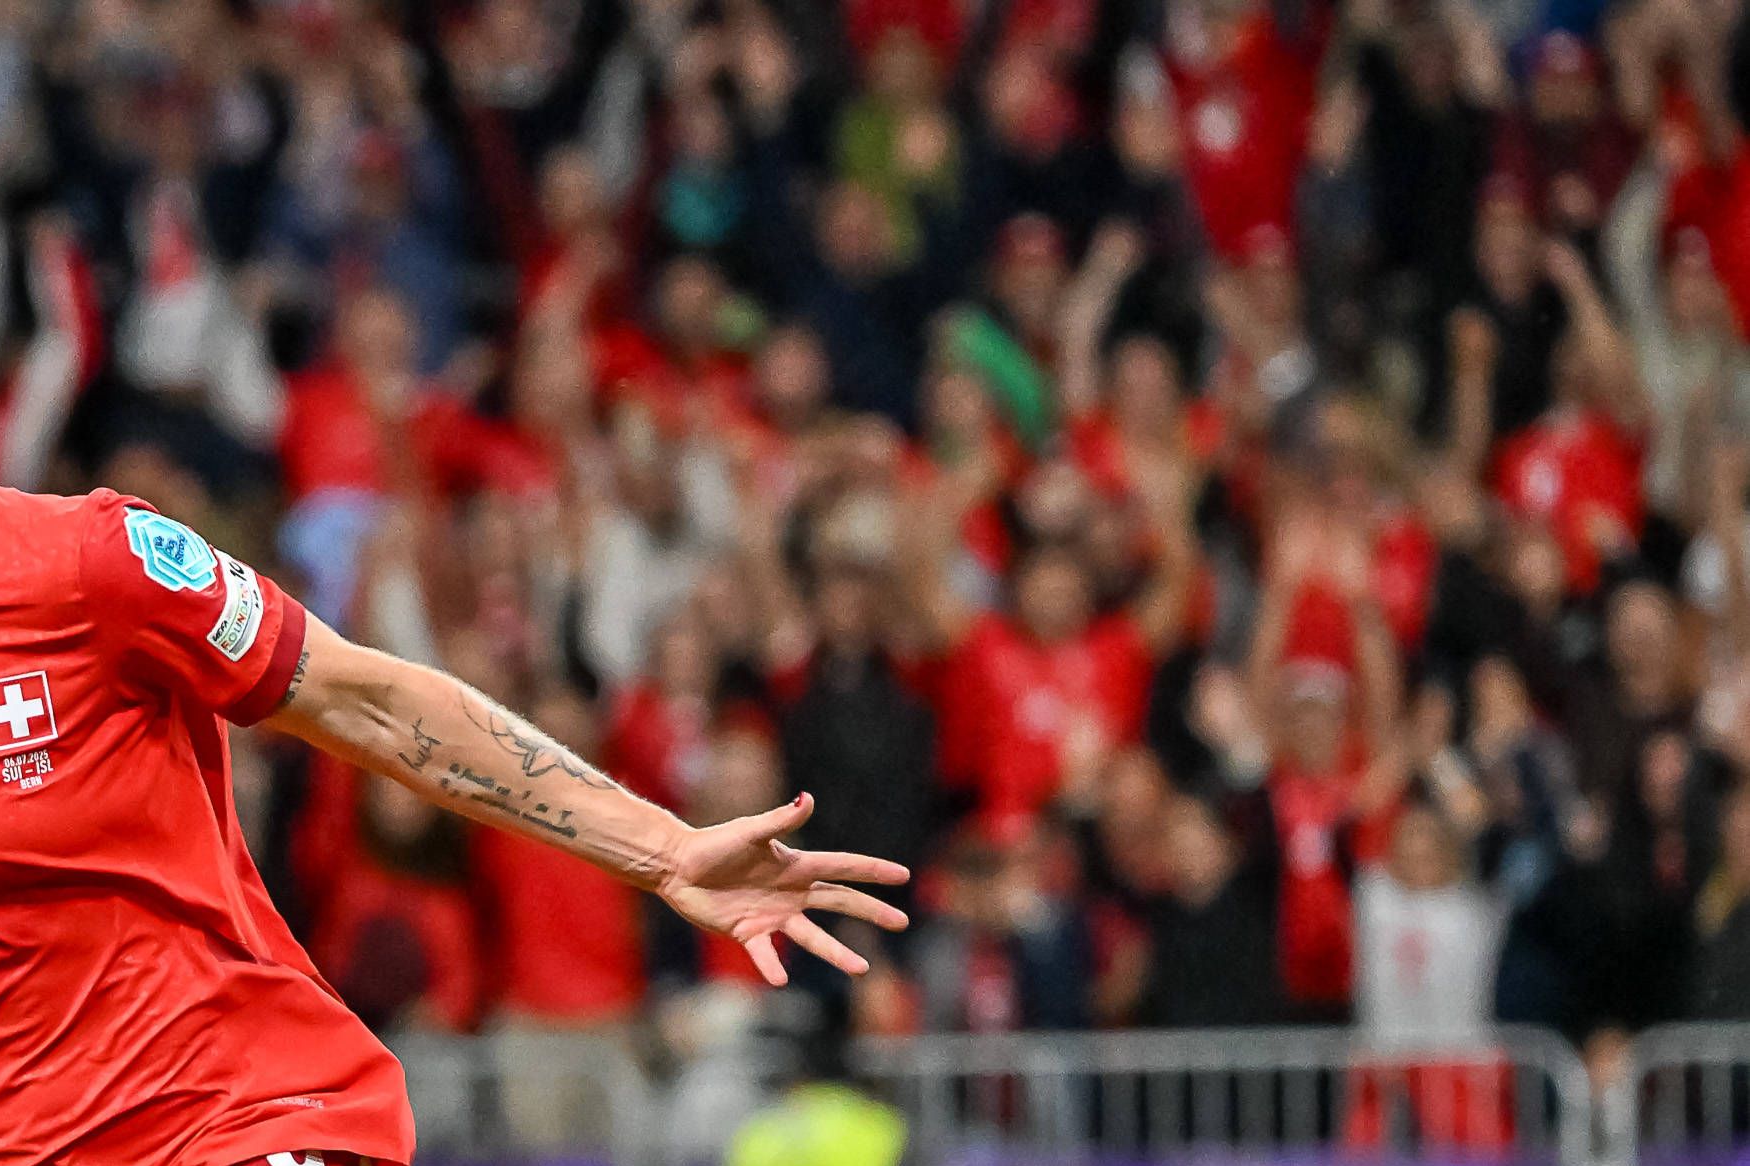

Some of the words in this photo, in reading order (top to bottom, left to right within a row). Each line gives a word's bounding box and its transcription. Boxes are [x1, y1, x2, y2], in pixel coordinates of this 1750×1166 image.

[212, 620, 229, 642] UEFA
[3, 749, 49, 768] 06.07.2025
[2, 765, 23, 783] SUI
[36, 758, 54, 775] ISL
[19, 775, 43, 790] BERN
